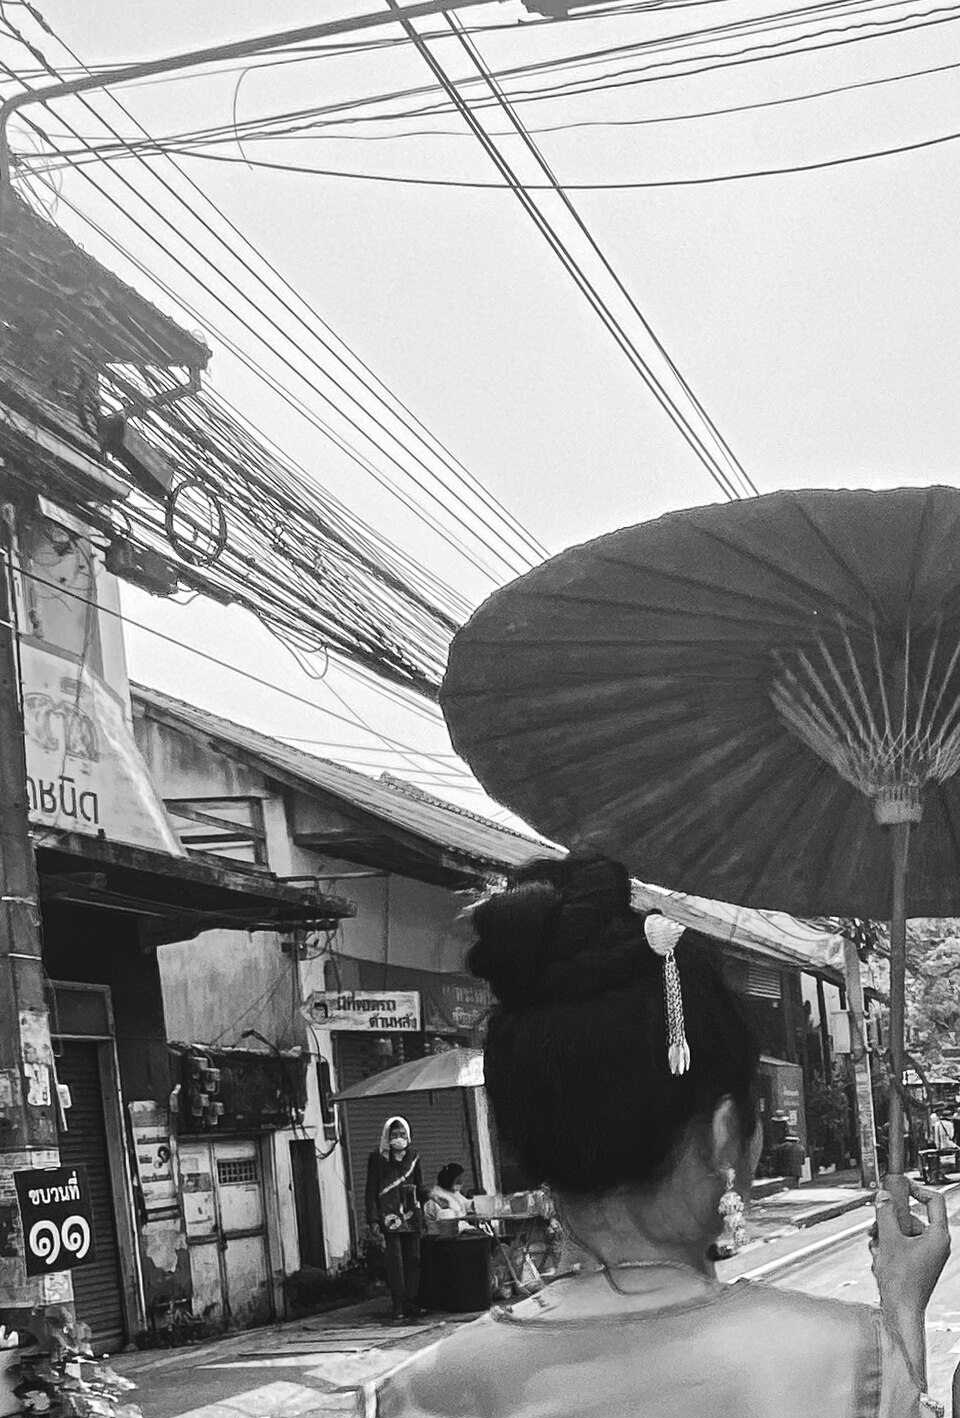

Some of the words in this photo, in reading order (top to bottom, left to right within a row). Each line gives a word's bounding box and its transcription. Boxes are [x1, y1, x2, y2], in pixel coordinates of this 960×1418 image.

[369, 1012, 418, 1029] ด้านหลัง
[28, 1170, 81, 1205] ขบวนที่
[29, 1215, 91, 1265] ๑๑
